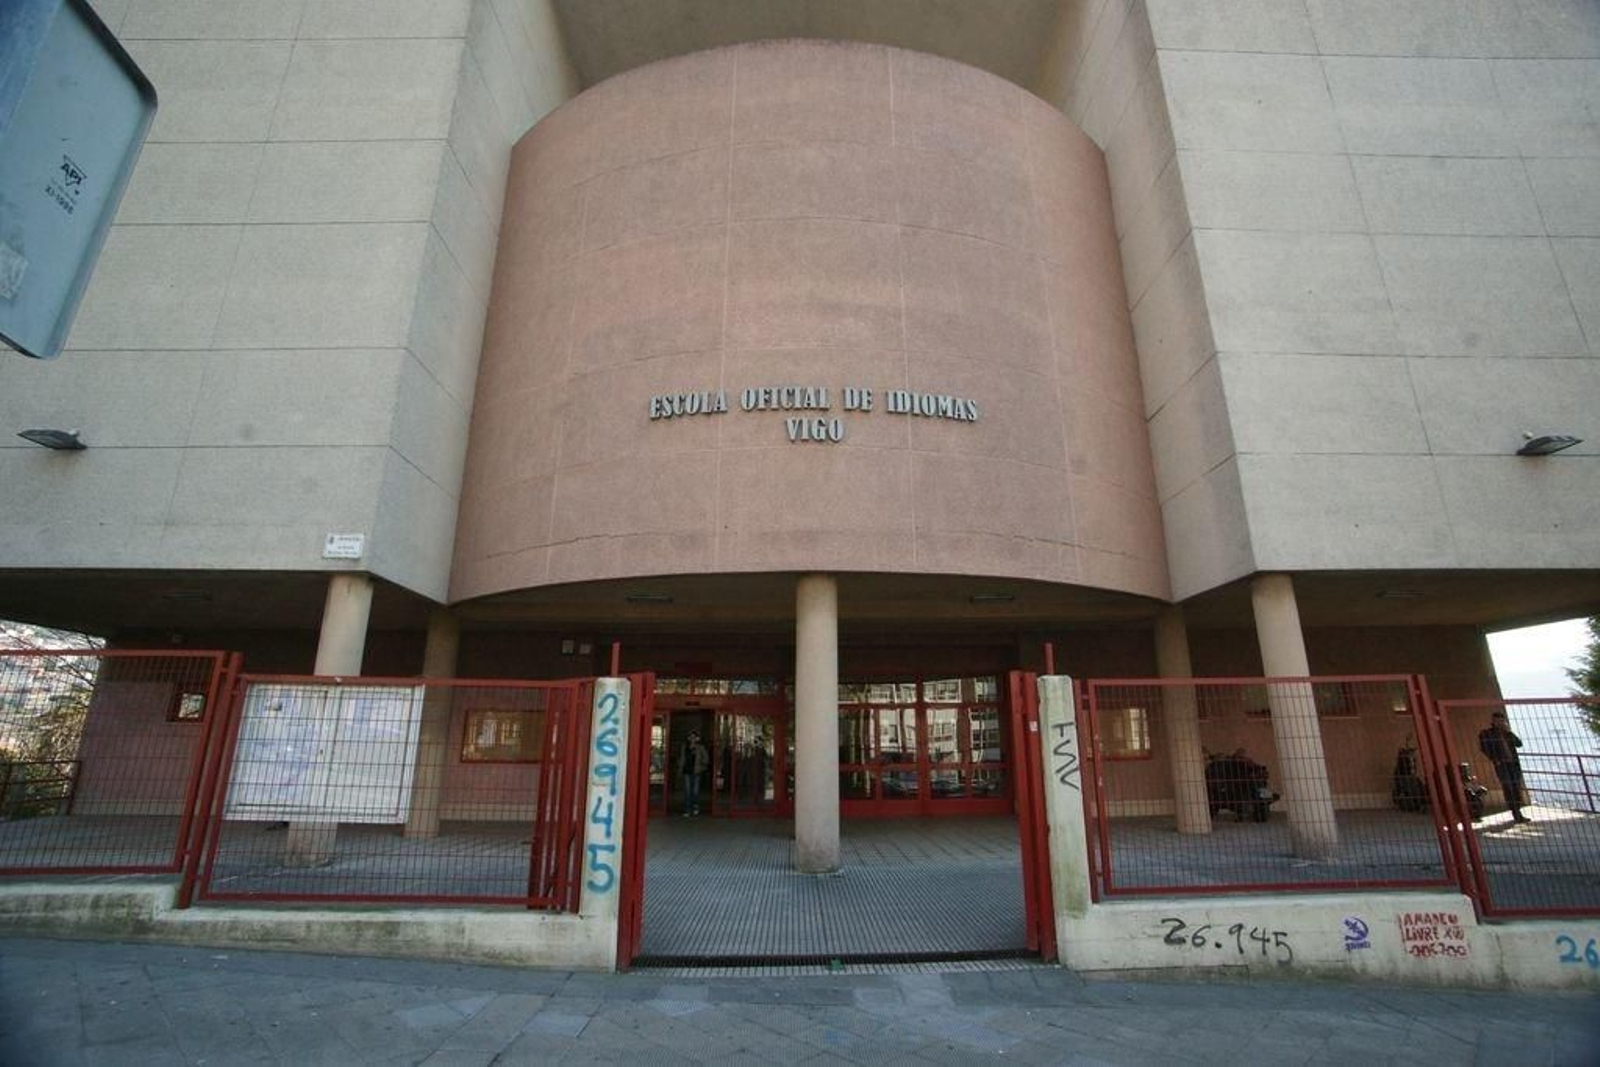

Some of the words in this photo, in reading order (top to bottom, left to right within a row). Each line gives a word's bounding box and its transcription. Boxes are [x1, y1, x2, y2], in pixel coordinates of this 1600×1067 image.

[649, 388, 727, 420] ESCOLA
[741, 386, 831, 412] OFICIAL
[843, 386, 873, 412] DE
[886, 390, 979, 423] IDIOMAS
[785, 416, 844, 443] VIGO
[1161, 917, 1293, 968] 26.945
